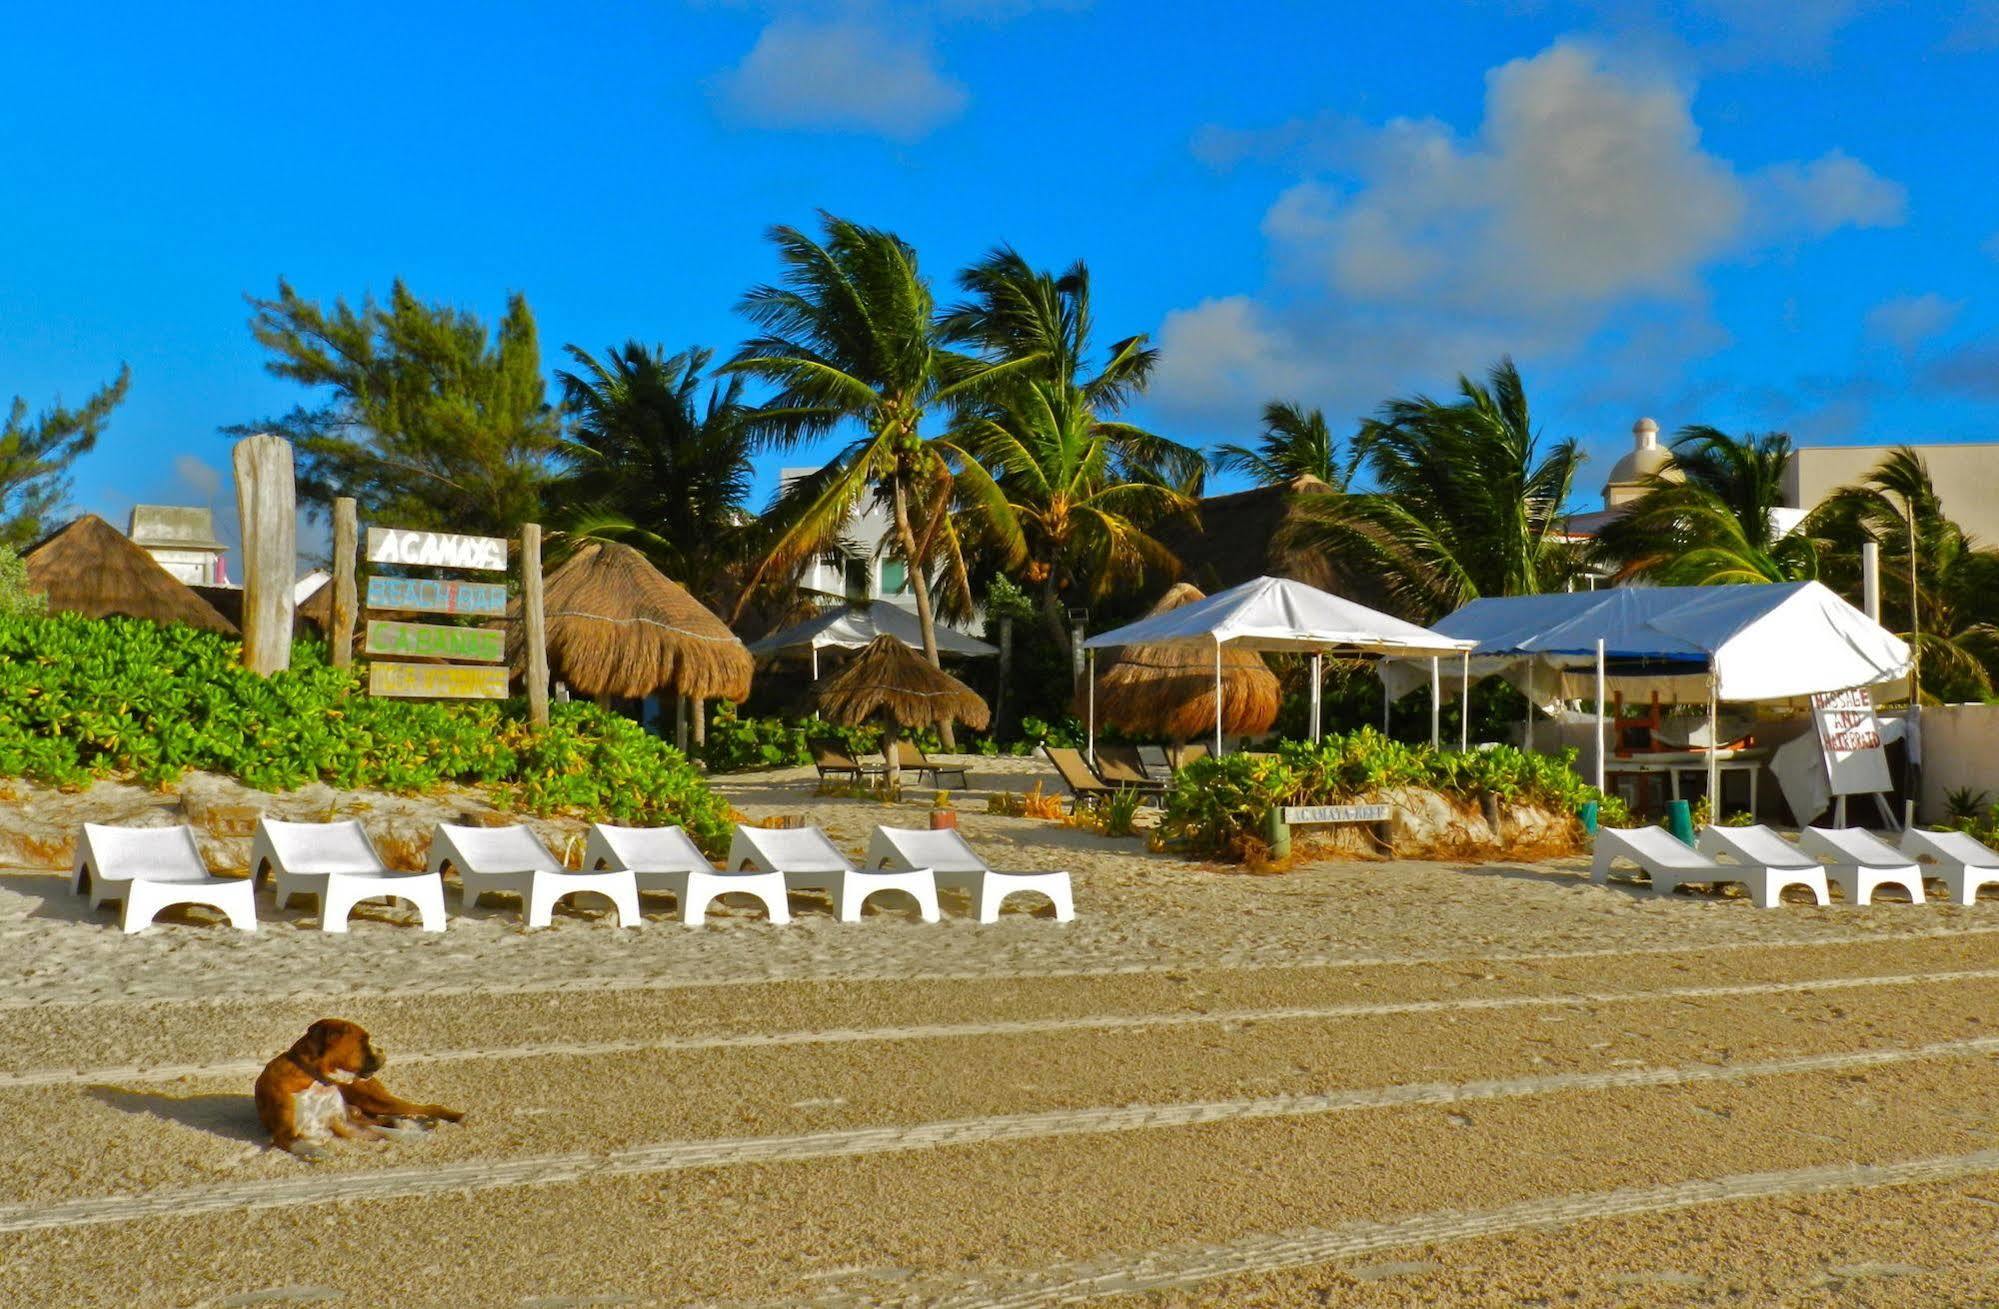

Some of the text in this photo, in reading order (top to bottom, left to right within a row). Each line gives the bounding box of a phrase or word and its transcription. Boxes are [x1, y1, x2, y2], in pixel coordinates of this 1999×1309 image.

[367, 579, 448, 609] BEACH
[458, 587, 506, 613] BAR
[373, 623, 499, 658] CABANAS
[1815, 688, 1870, 709] MASSAGE
[1835, 711, 1862, 728] AND
